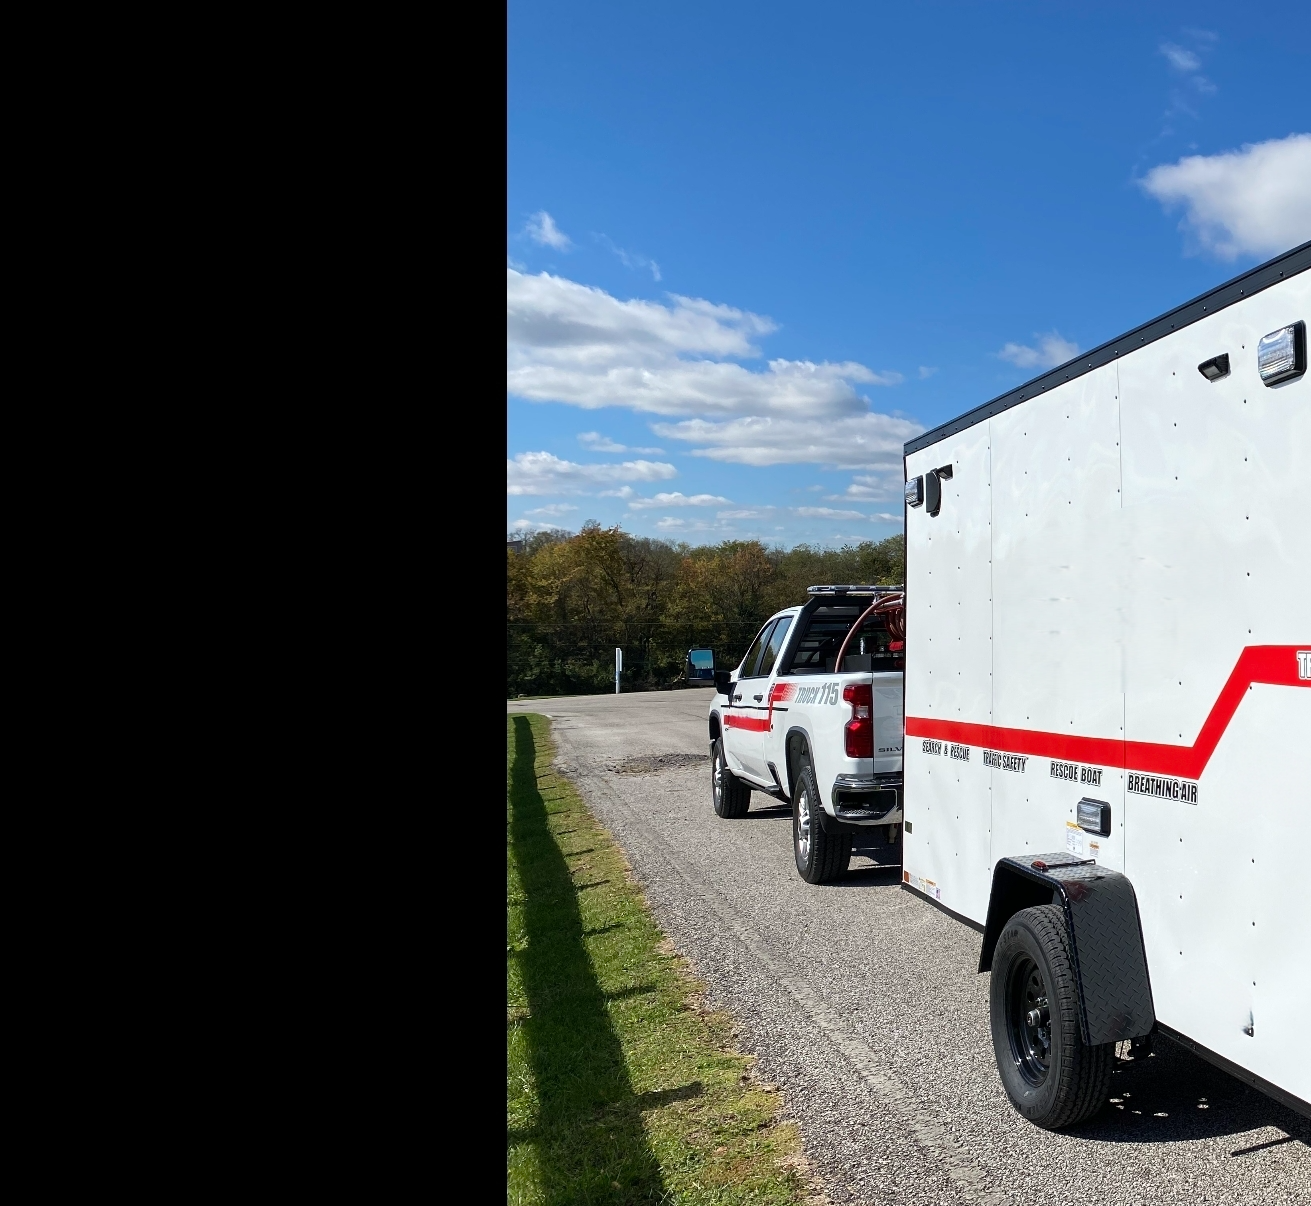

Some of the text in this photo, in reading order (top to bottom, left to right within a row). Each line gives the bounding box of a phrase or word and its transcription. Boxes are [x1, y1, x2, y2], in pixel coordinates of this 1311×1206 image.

[818, 681, 840, 706] 115
[950, 743, 970, 762] RESCUE
[983, 749, 1027, 773] TRAFFIC SAFETY
[1080, 766, 1103, 787] BOAT
[1127, 771, 1198, 806] BREATHING AIR
